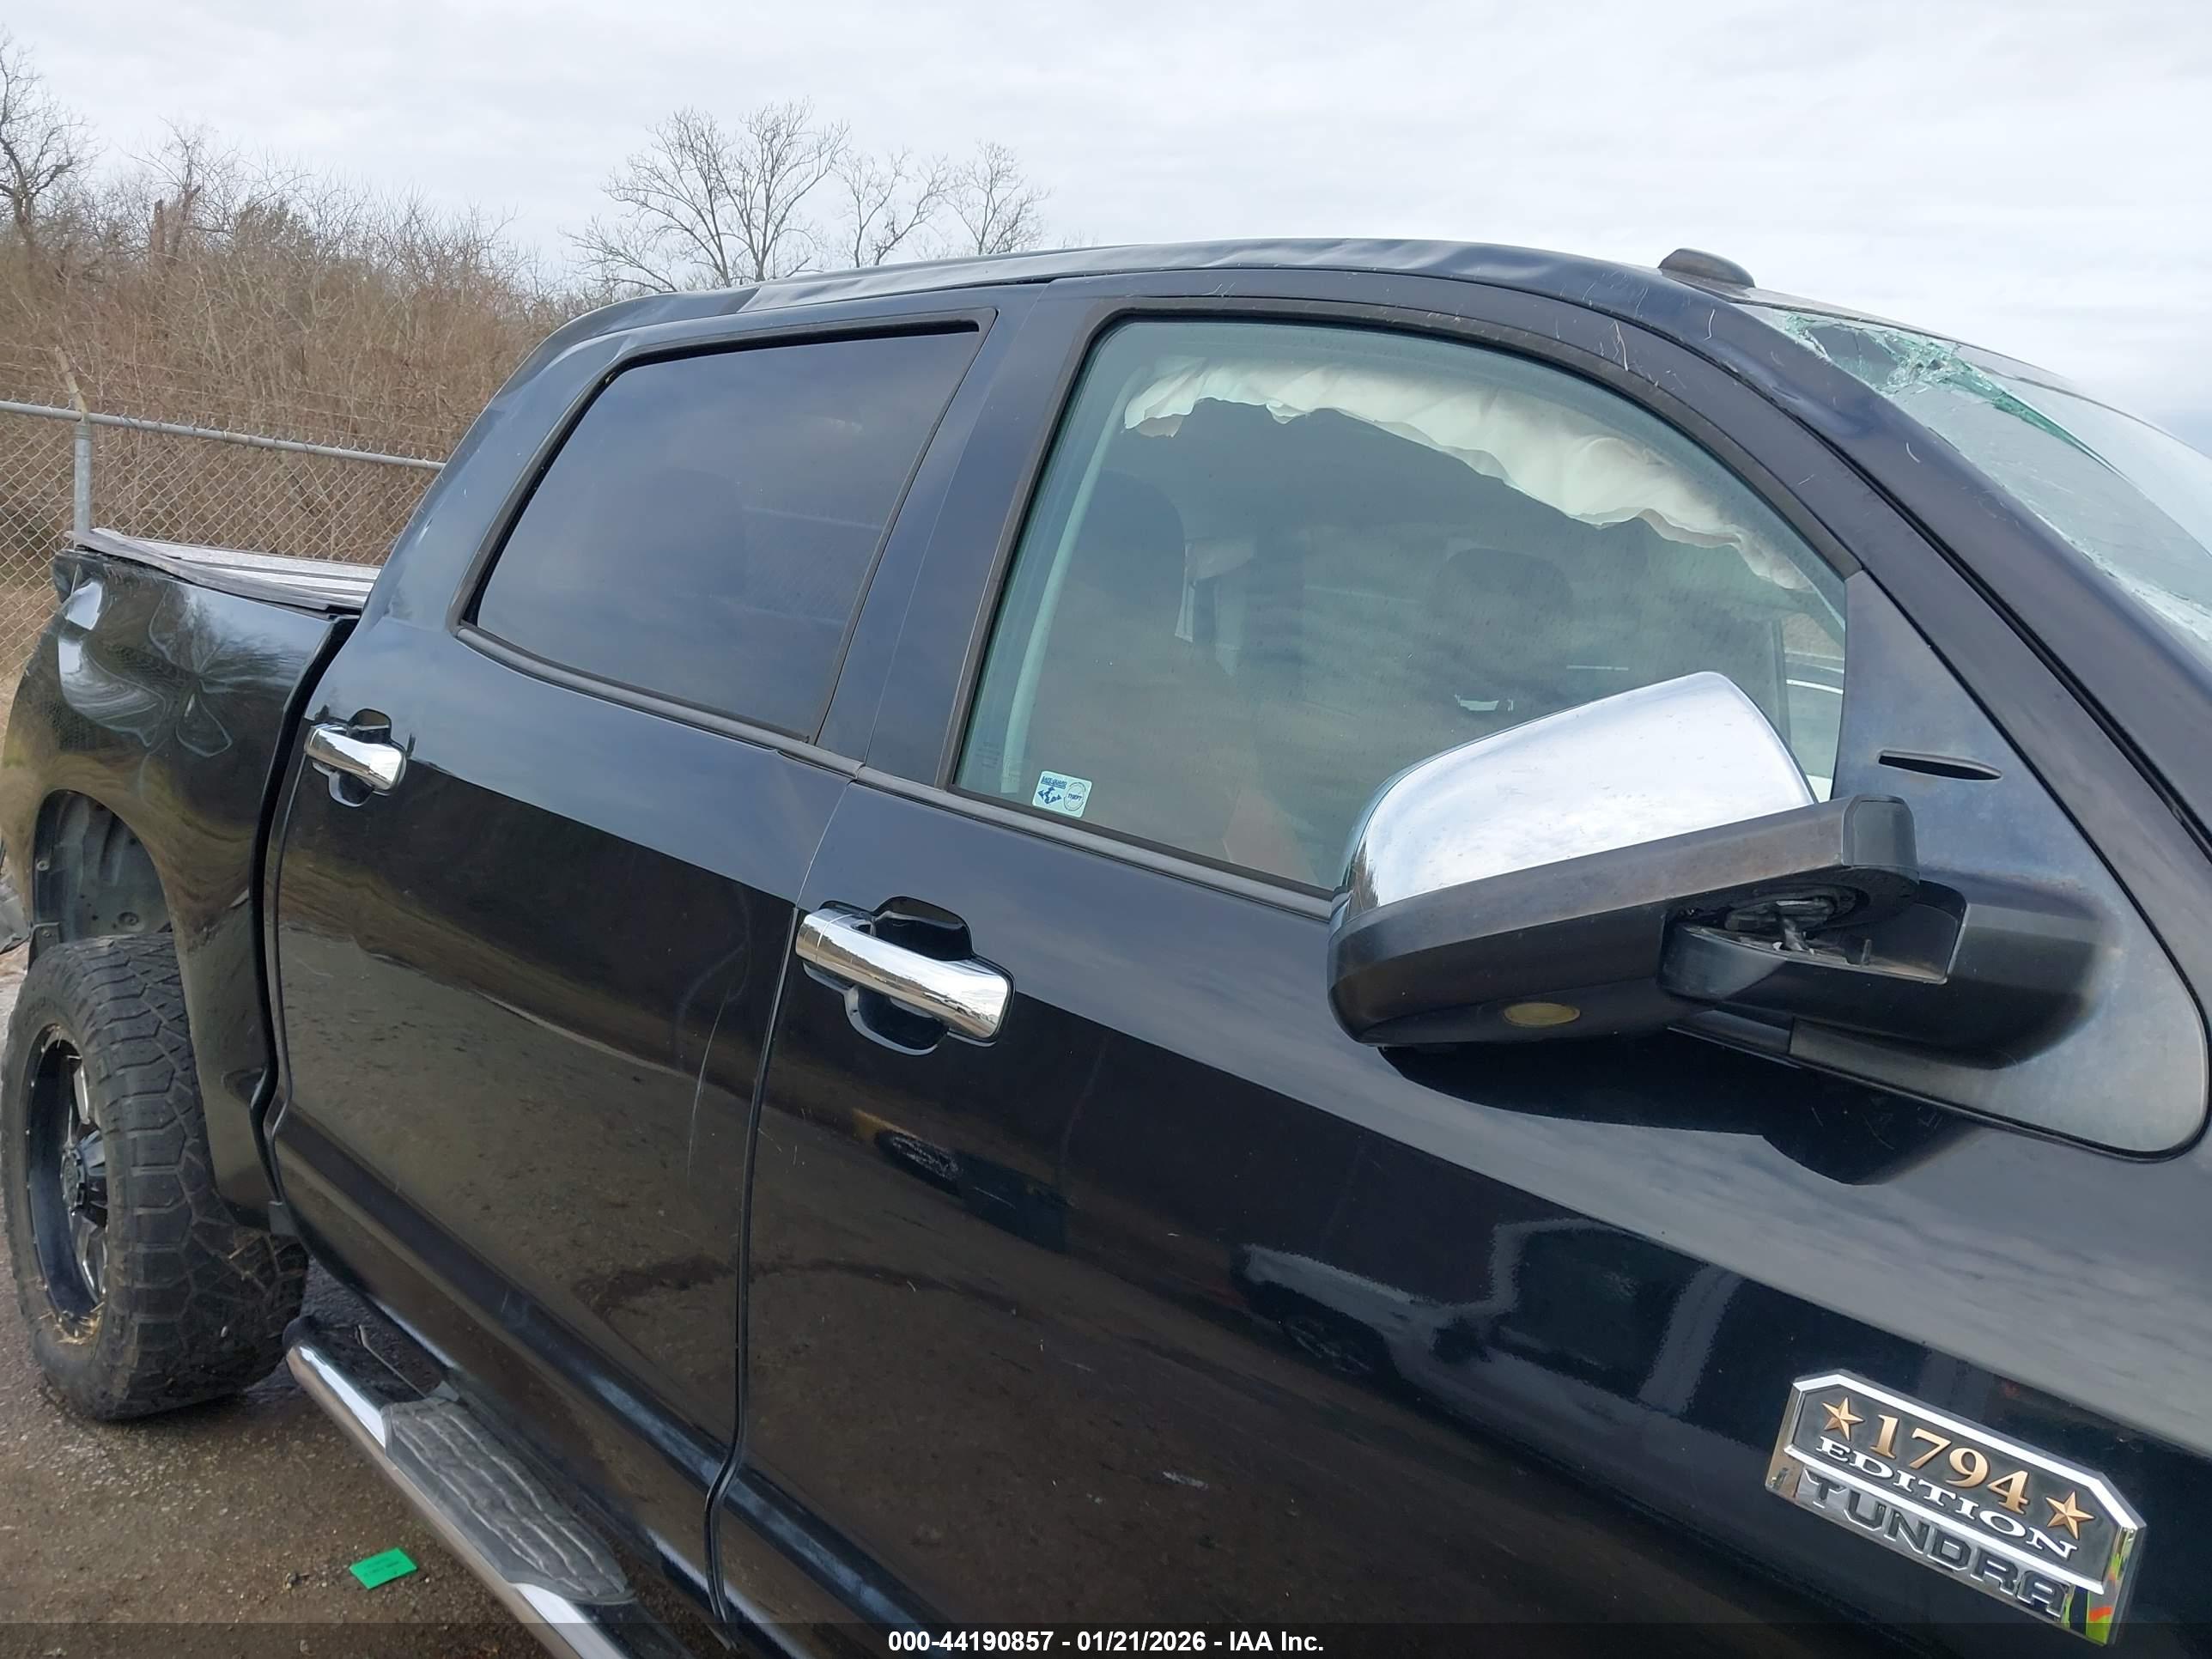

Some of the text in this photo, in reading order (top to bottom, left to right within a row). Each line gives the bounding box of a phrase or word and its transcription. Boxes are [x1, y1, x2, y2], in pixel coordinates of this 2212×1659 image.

[1815, 1435, 2079, 1561] EDITION
[1869, 1413, 2031, 1515] 1794
[1804, 1468, 2069, 1620] TUNDRA
